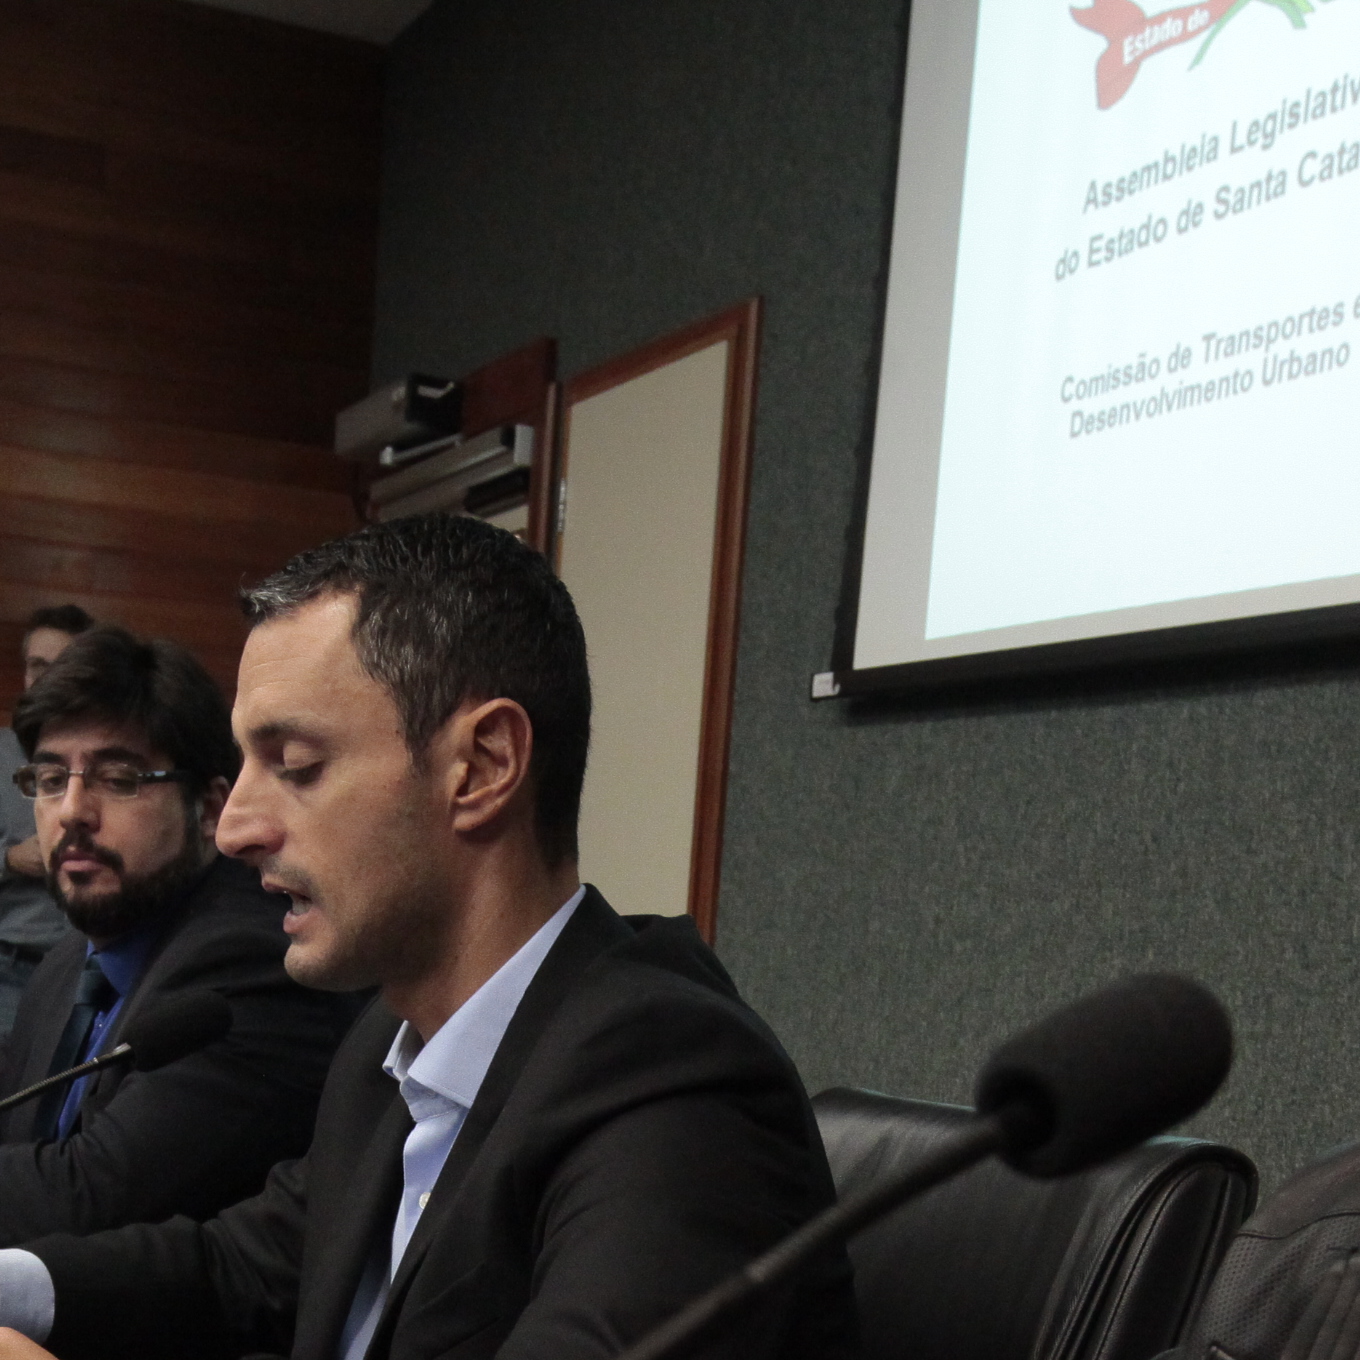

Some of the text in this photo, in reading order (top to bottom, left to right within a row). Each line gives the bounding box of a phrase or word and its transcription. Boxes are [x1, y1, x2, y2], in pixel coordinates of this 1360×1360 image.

[1123, 7, 1211, 66] Estado de
[1081, 130, 1219, 214] Assembleia
[1054, 246, 1079, 282] do
[1086, 214, 1168, 268] Estado
[1176, 196, 1204, 235] de
[1212, 171, 1288, 223] Santa
[1060, 351, 1161, 406] Comissão
[1166, 340, 1193, 371] de
[1202, 304, 1345, 366] Transportes
[1069, 338, 1351, 439] Desenvolvimento Urbano
